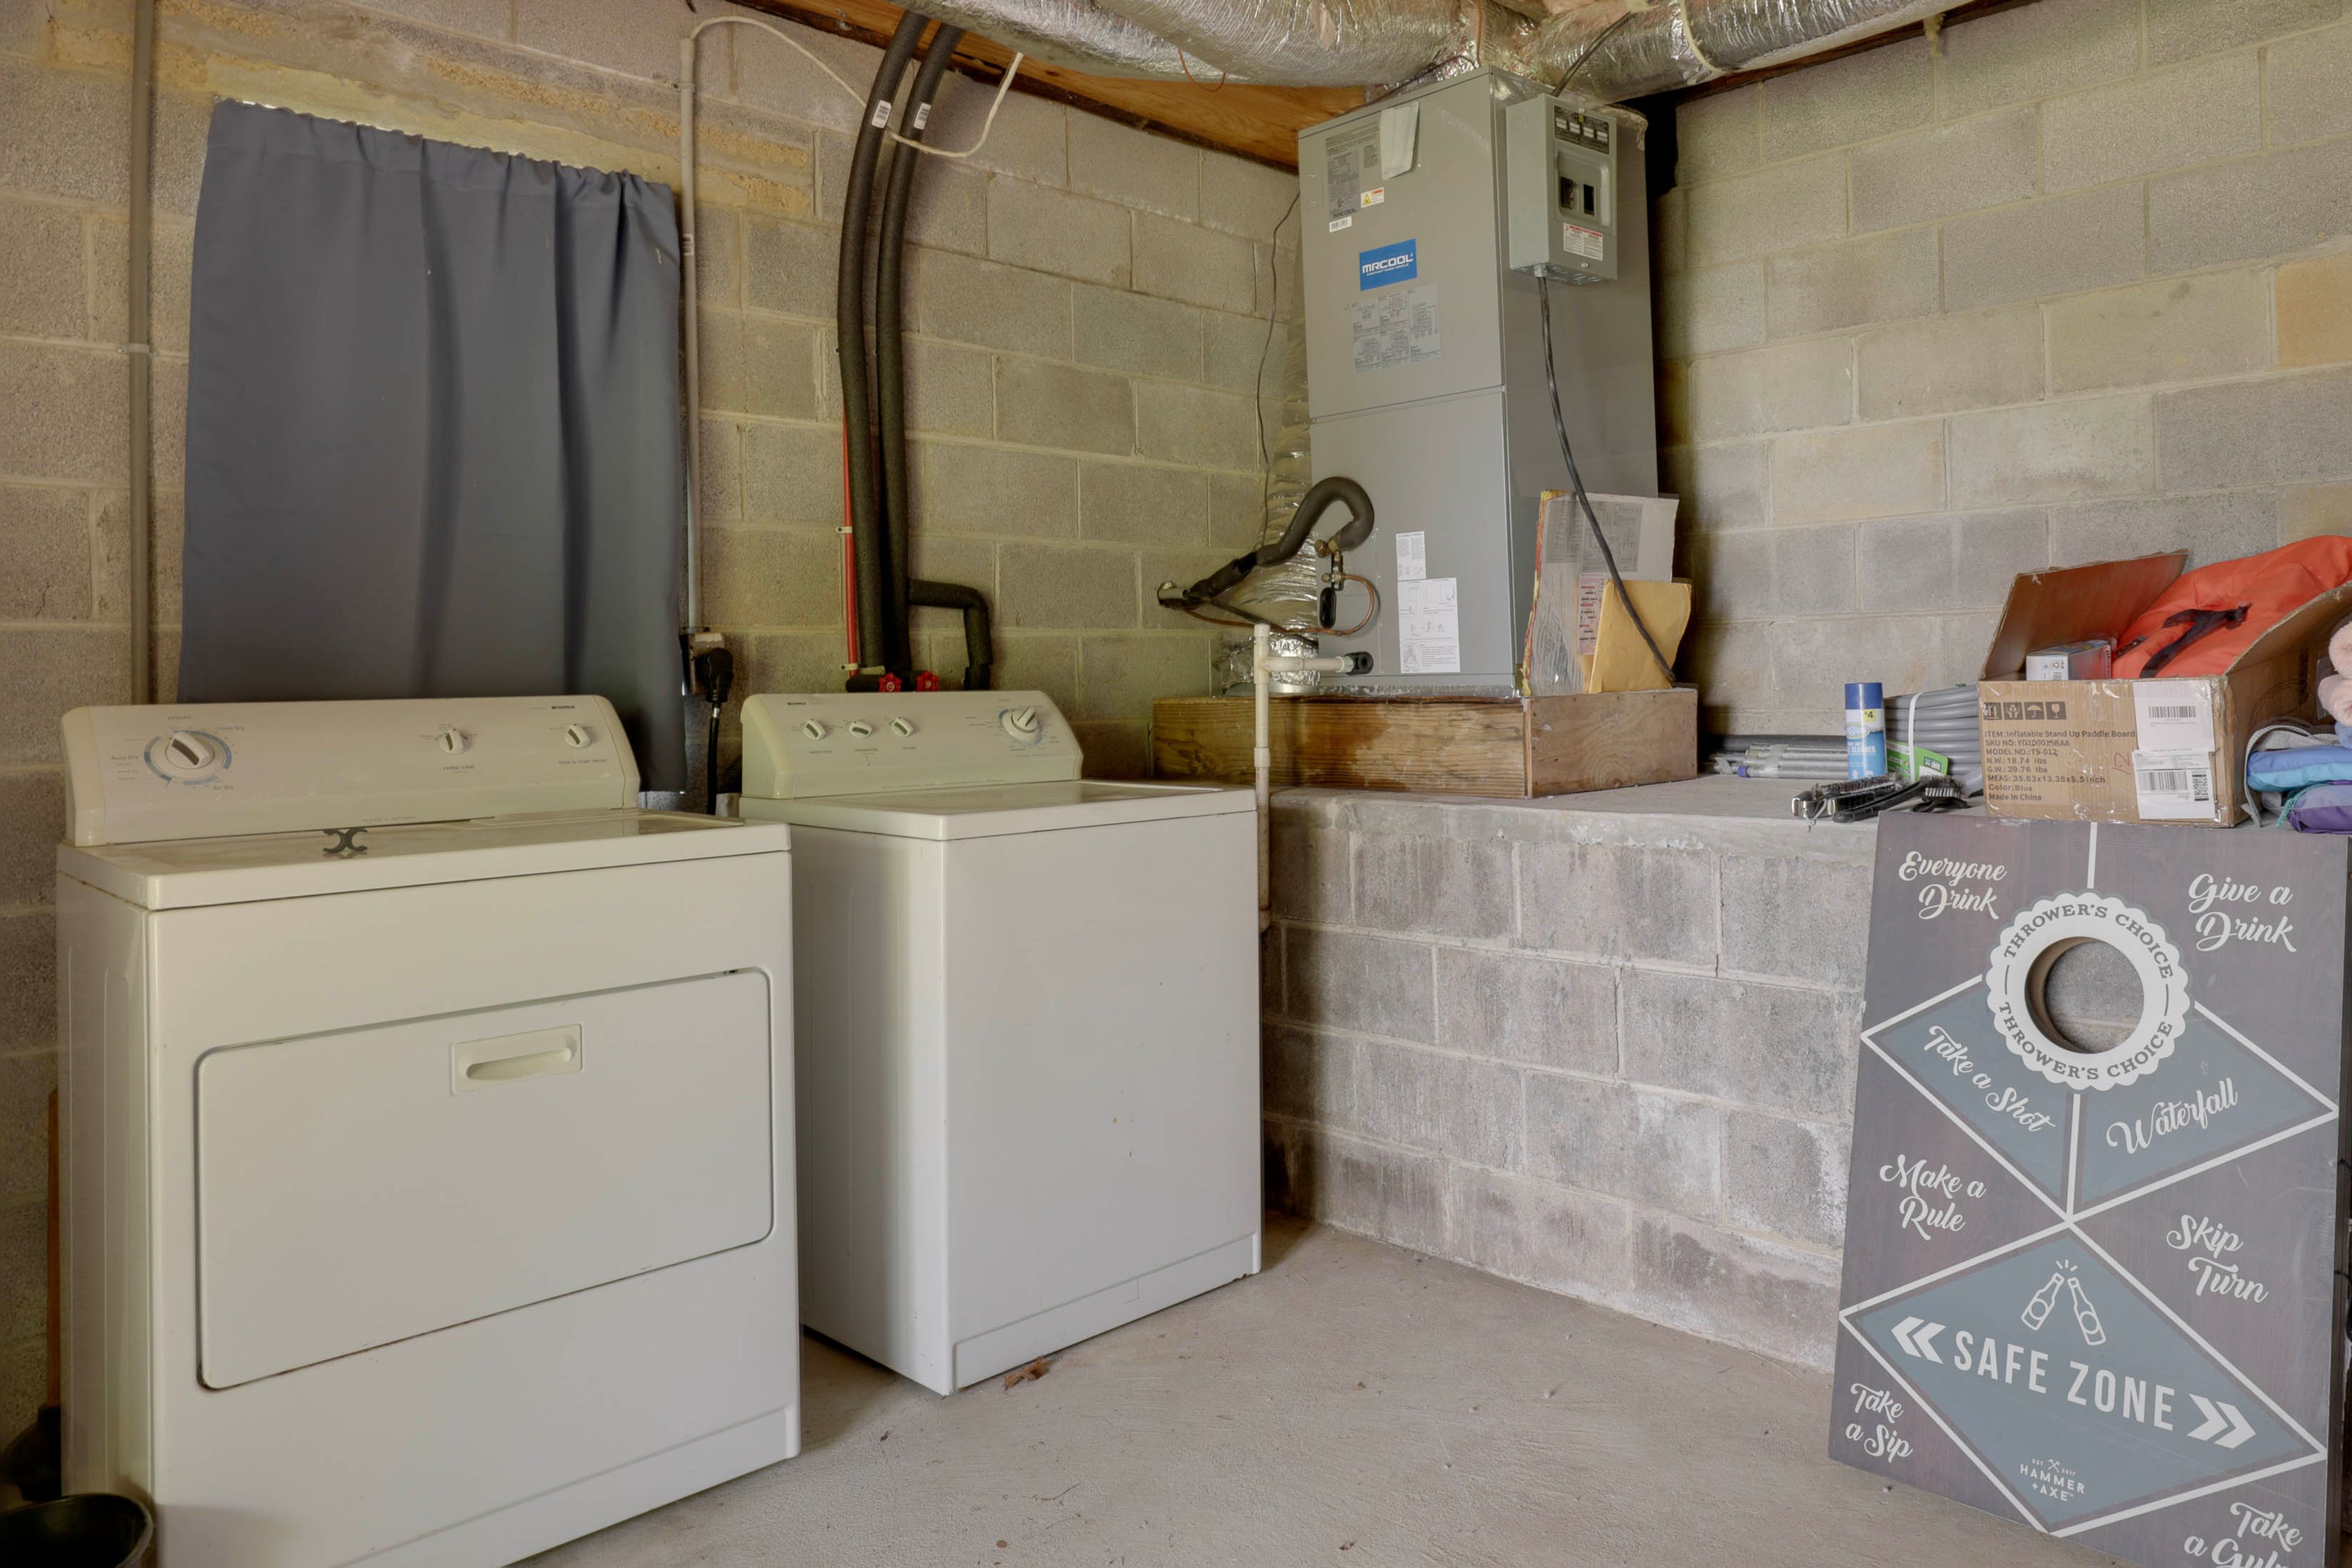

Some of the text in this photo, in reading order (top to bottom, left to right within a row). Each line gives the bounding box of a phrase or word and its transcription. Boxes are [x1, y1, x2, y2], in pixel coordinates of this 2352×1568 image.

[1362, 253, 1414, 274] MRCOOL
[1899, 851, 2007, 886] Everyone
[1918, 884, 1999, 919] Drink
[2188, 873, 2294, 913] Give a
[2003, 903, 2174, 979] THROWER'S CHOICE
[2195, 911, 2297, 952] Drink
[1999, 1001, 2173, 1080] THROWER'S CHOICE
[1924, 1025, 2056, 1132] Take a Shot
[2106, 1077, 2238, 1154] Waterfall
[1879, 1154, 1987, 1199] Make a
[1899, 1196, 1966, 1241] Rule
[2166, 1215, 2244, 1259] Skip
[2188, 1256, 2269, 1303] Turn
[1954, 1330, 2175, 1431] SAFE ZONE
[1850, 1383, 1904, 1423] Take
[1845, 1423, 1913, 1463] a Sip
[2020, 1463, 2085, 1494] HAMMER
[2230, 1502, 2303, 1553] Take
[2184, 1536, 2290, 1568] a Gul
